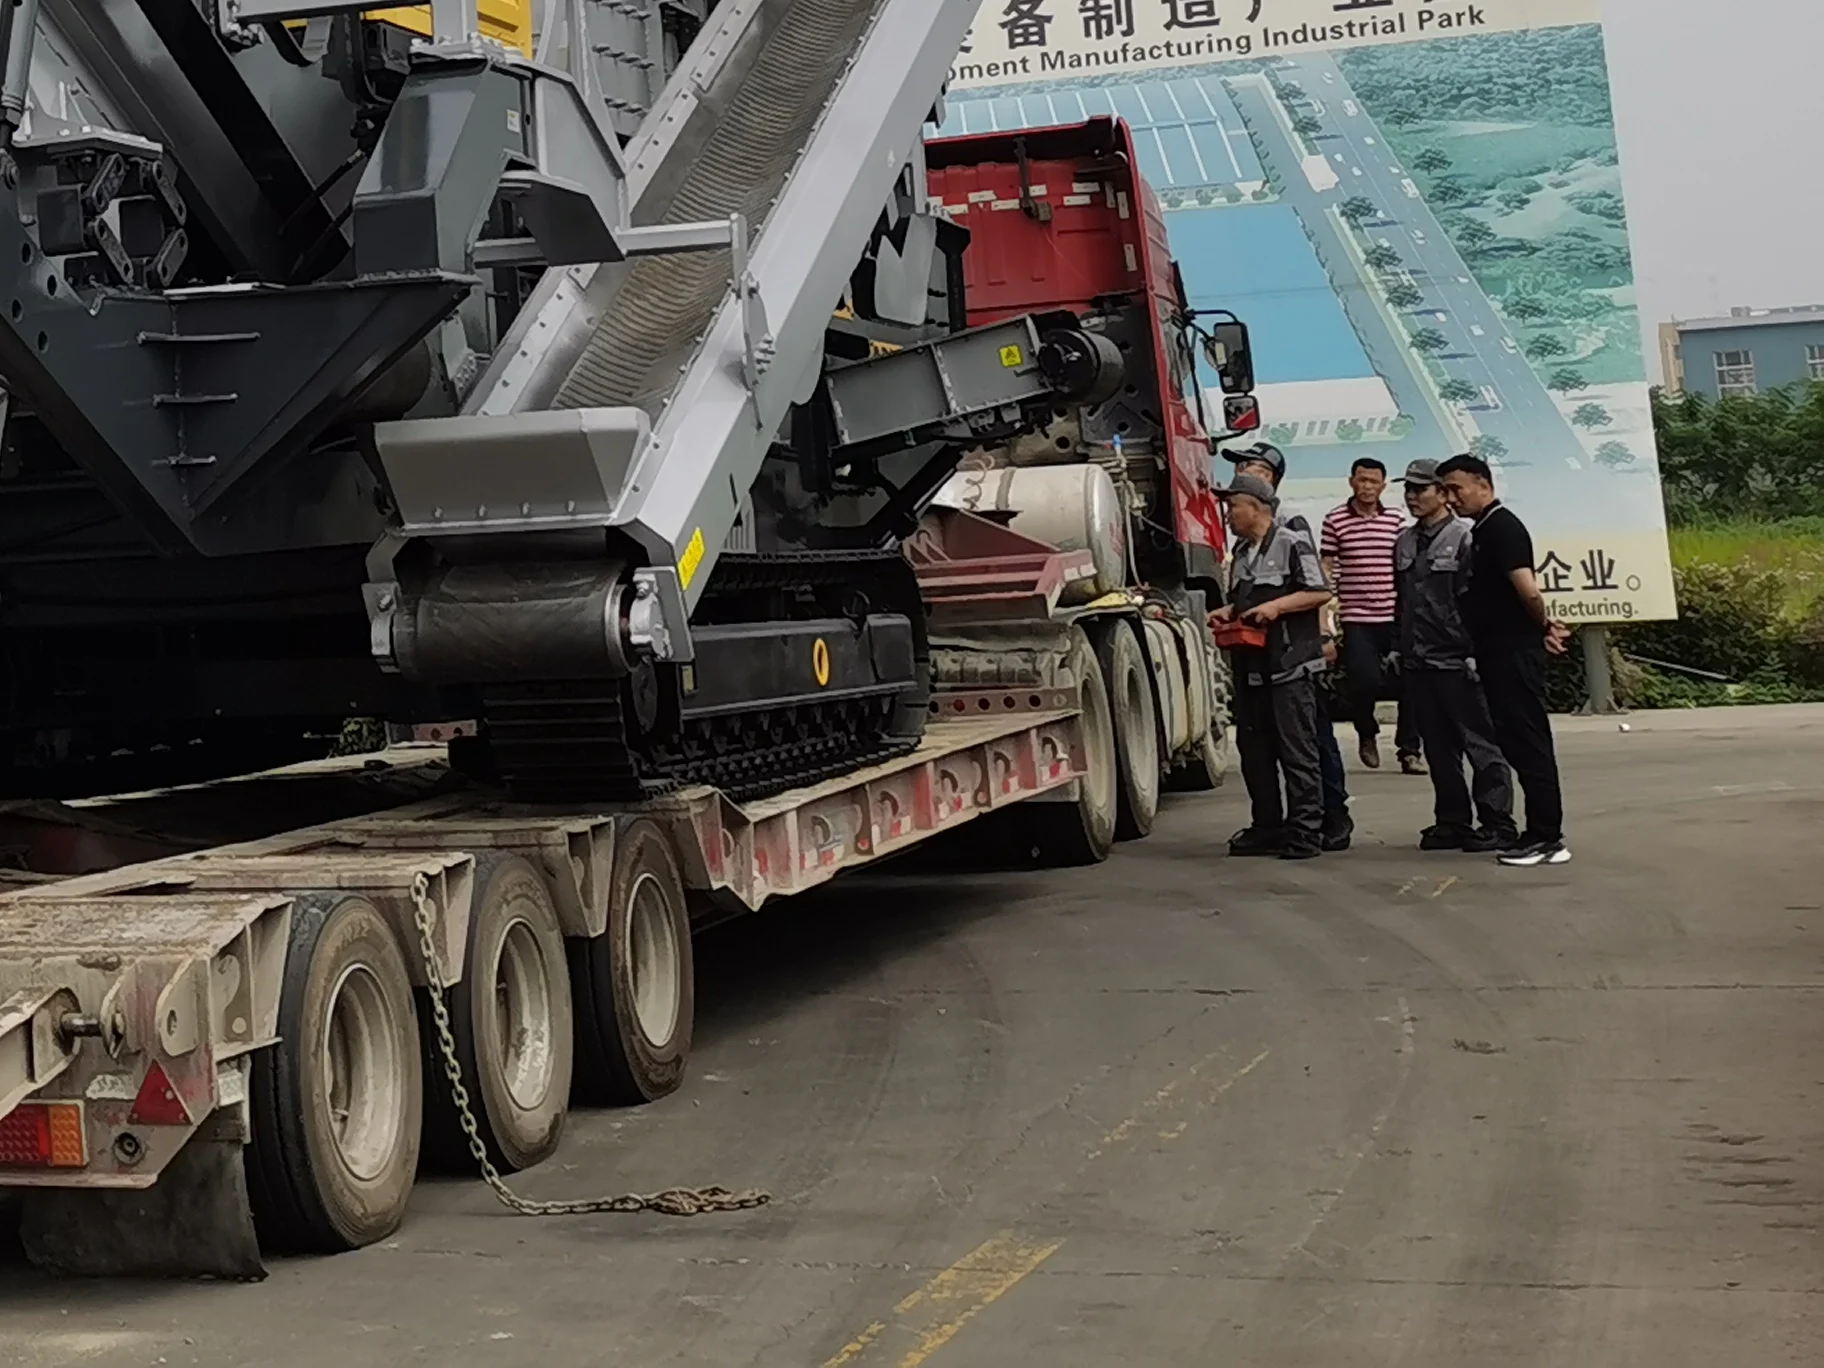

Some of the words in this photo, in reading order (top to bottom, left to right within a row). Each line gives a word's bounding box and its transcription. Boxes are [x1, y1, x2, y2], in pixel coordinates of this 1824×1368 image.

[1040, 31, 1252, 73] Manufacturing
[1262, 12, 1406, 48] Industrial
[1418, 4, 1485, 31] Park
